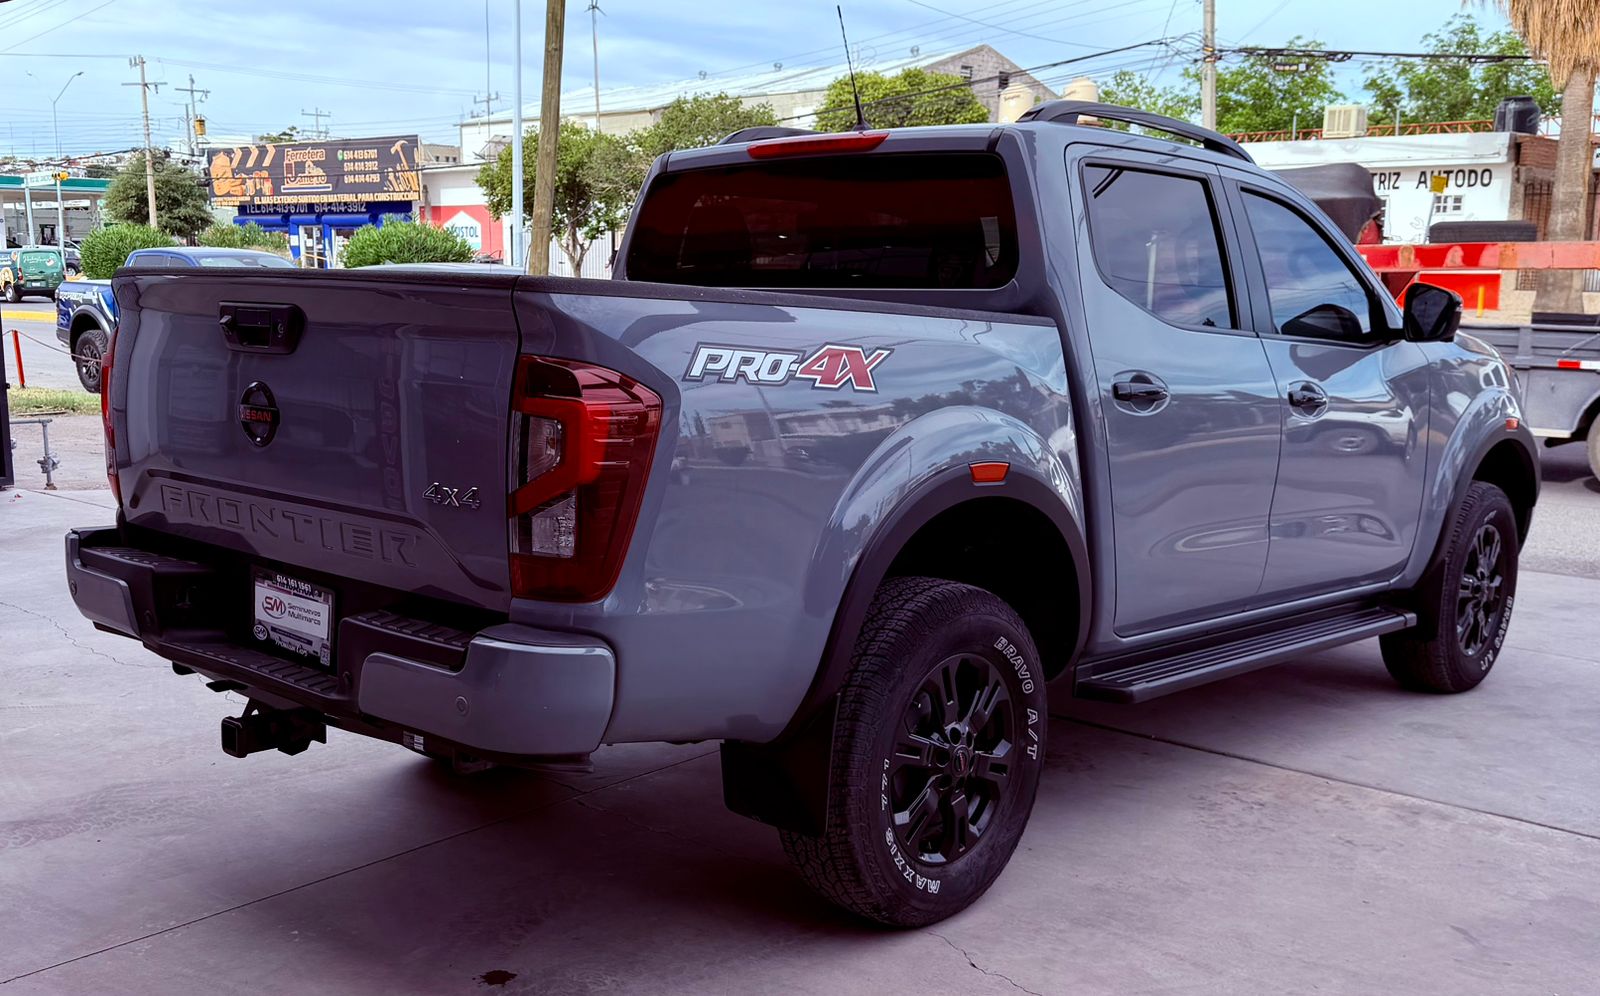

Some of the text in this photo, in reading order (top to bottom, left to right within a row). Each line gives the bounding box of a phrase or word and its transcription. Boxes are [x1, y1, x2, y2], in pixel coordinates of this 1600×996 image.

[357, 193, 373, 202] PARA
[1416, 168, 1493, 190] ATODO
[160, 484, 419, 568] FRONTIER
[994, 636, 1034, 695] BRAVO
[1026, 707, 1038, 760] A/T
[885, 827, 941, 894] MAXXIS
